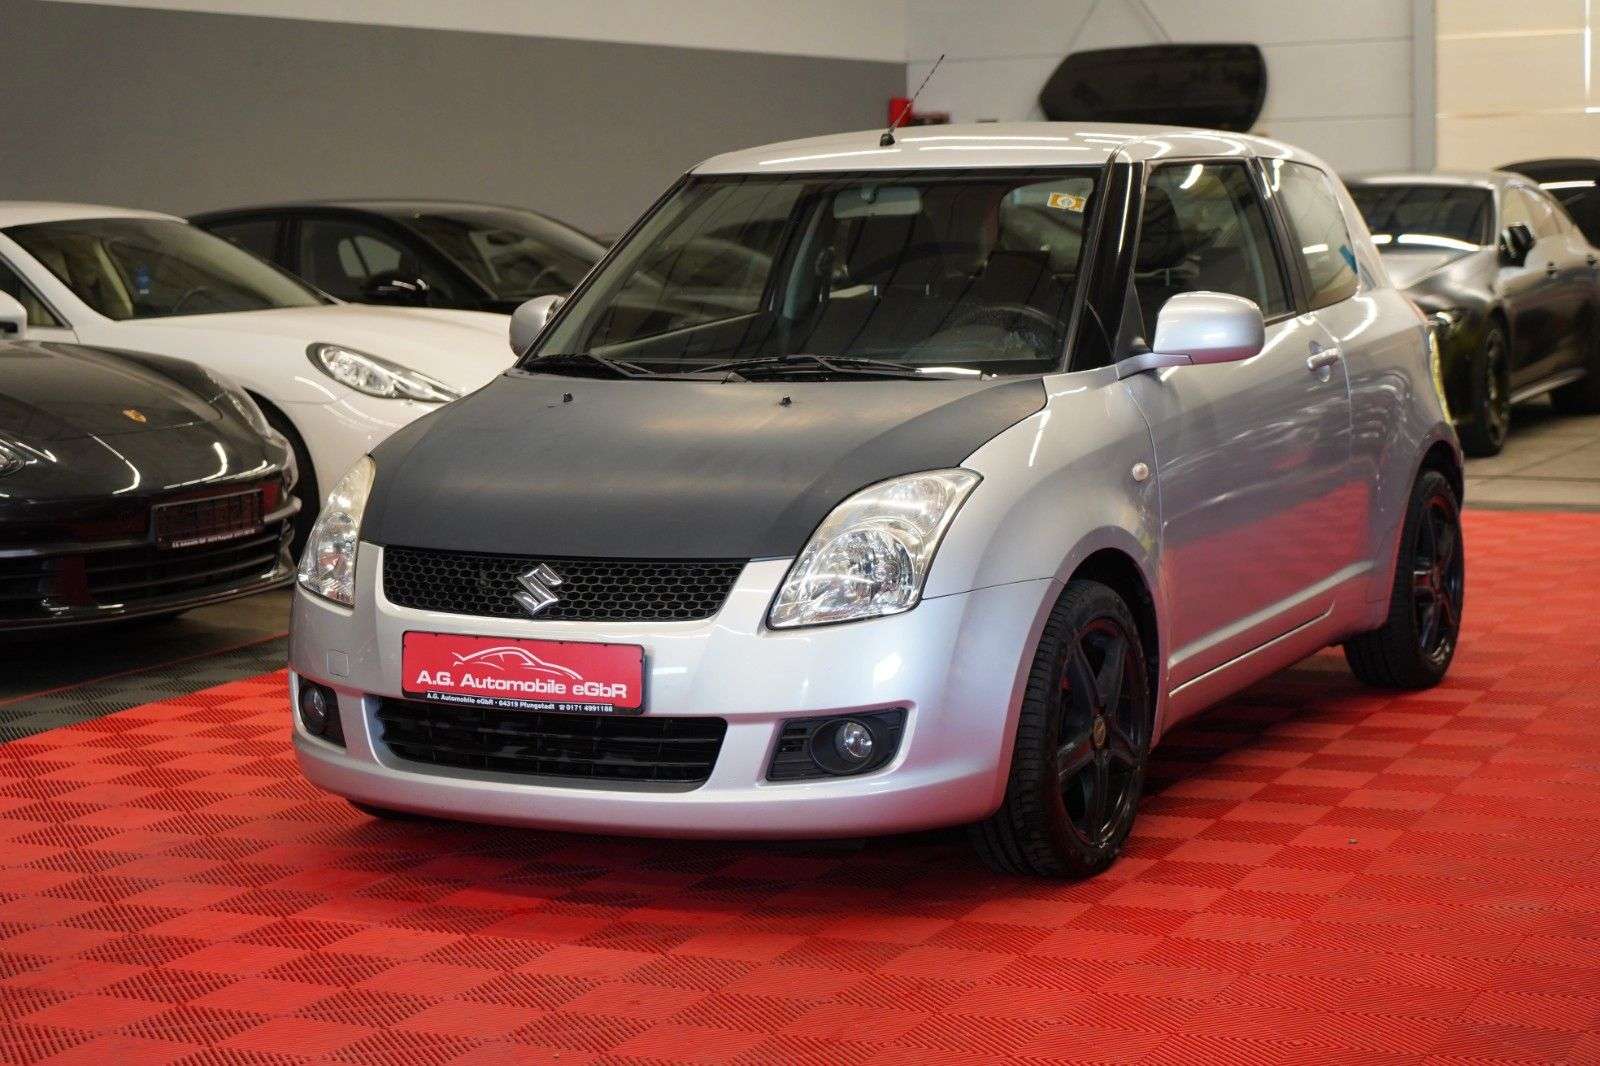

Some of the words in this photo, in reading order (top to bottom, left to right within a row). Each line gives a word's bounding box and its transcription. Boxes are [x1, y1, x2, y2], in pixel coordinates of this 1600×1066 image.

[416, 670, 454, 686] A.G.
[460, 673, 566, 694] Automobile
[572, 681, 627, 699] eGbR
[440, 694, 476, 704] Automobile
[476, 698, 494, 706] eGbR
[519, 702, 555, 710] Pfungstadt
